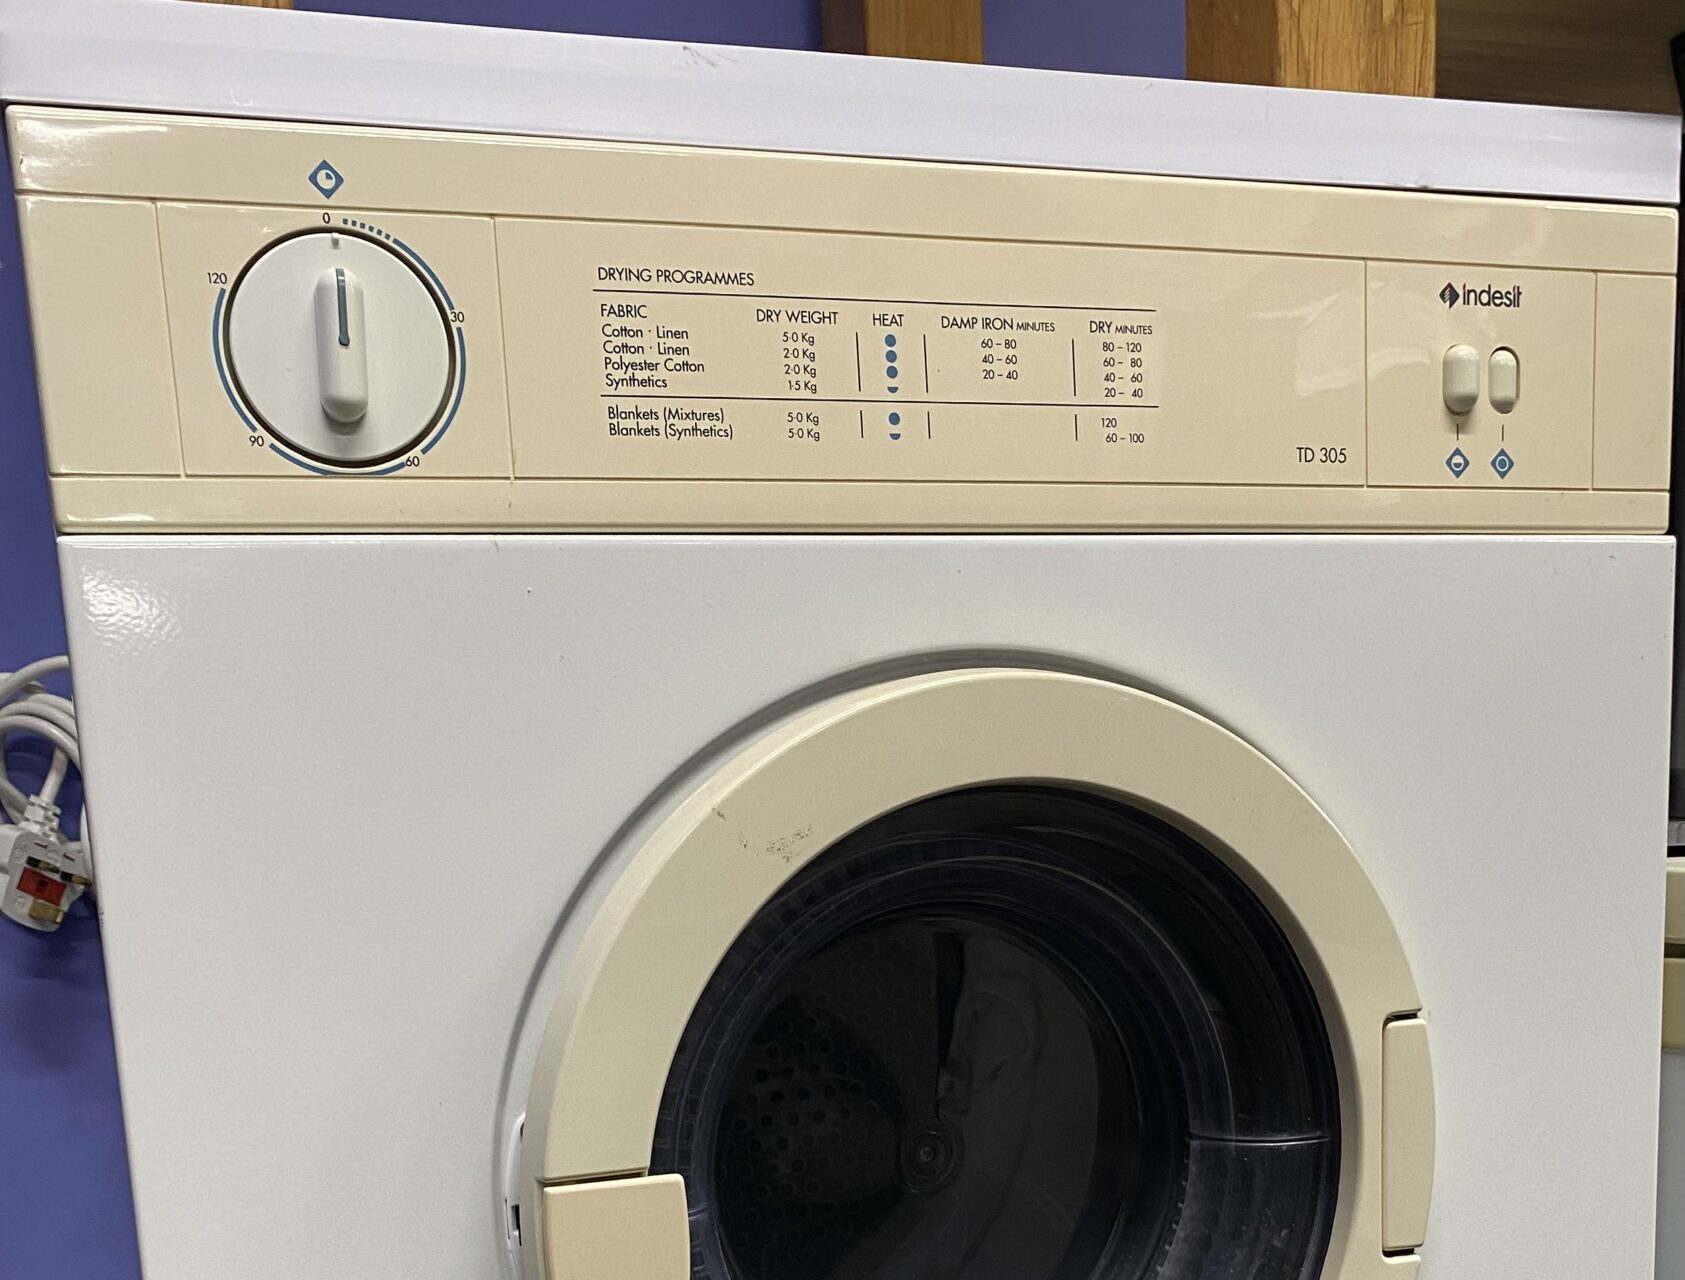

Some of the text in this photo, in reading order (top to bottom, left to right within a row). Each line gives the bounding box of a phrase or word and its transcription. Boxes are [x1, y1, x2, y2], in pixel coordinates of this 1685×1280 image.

[322, 212, 331, 224] 0
[207, 272, 227, 285] 120
[597, 266, 755, 287] DRYING PROGRAMMES
[1462, 283, 1522, 308] Indesit
[449, 311, 465, 323] 30
[600, 303, 648, 319] FABRIC
[756, 308, 839, 326] DRY WEIGHT
[872, 312, 905, 328] HEAT
[940, 315, 1056, 333] DAMP IRON MINUTES
[601, 323, 644, 338] Cotton
[656, 325, 689, 340] Linen
[1089, 320, 1153, 336] DRY MINUTES
[801, 332, 815, 346] Kg
[980, 338, 993, 349] 60
[1004, 338, 1017, 350] 80
[602, 340, 645, 355] Cotton
[657, 341, 690, 356] Linen
[1102, 341, 1115, 352] 80
[1125, 342, 1142, 353] 120
[802, 348, 816, 362] Kg
[981, 353, 994, 365] 40
[1005, 354, 1018, 365] 60
[604, 356, 705, 374] Polyester Cotton
[1103, 357, 1115, 368] 60
[1130, 357, 1143, 369] 80
[803, 364, 817, 378] Kg
[982, 369, 995, 380] 20
[1005, 369, 1019, 381] 40
[1103, 372, 1116, 383] 40
[1130, 372, 1143, 384] 60
[605, 373, 668, 391] Synthetics
[804, 380, 818, 394] Kg
[1104, 387, 1117, 398] 20
[1131, 388, 1144, 399] 40
[607, 406, 725, 423] Blankets (Mixtures)
[806, 412, 820, 427] Kg
[1100, 417, 1118, 429] 120
[608, 422, 734, 441] Blankets (Synthetics)
[806, 428, 821, 442] Kg
[1105, 432, 1118, 443] 60
[1128, 432, 1145, 444] 100
[248, 435, 265, 447] 90
[404, 455, 420, 468] 60
[1295, 446, 1347, 464] TD 305
